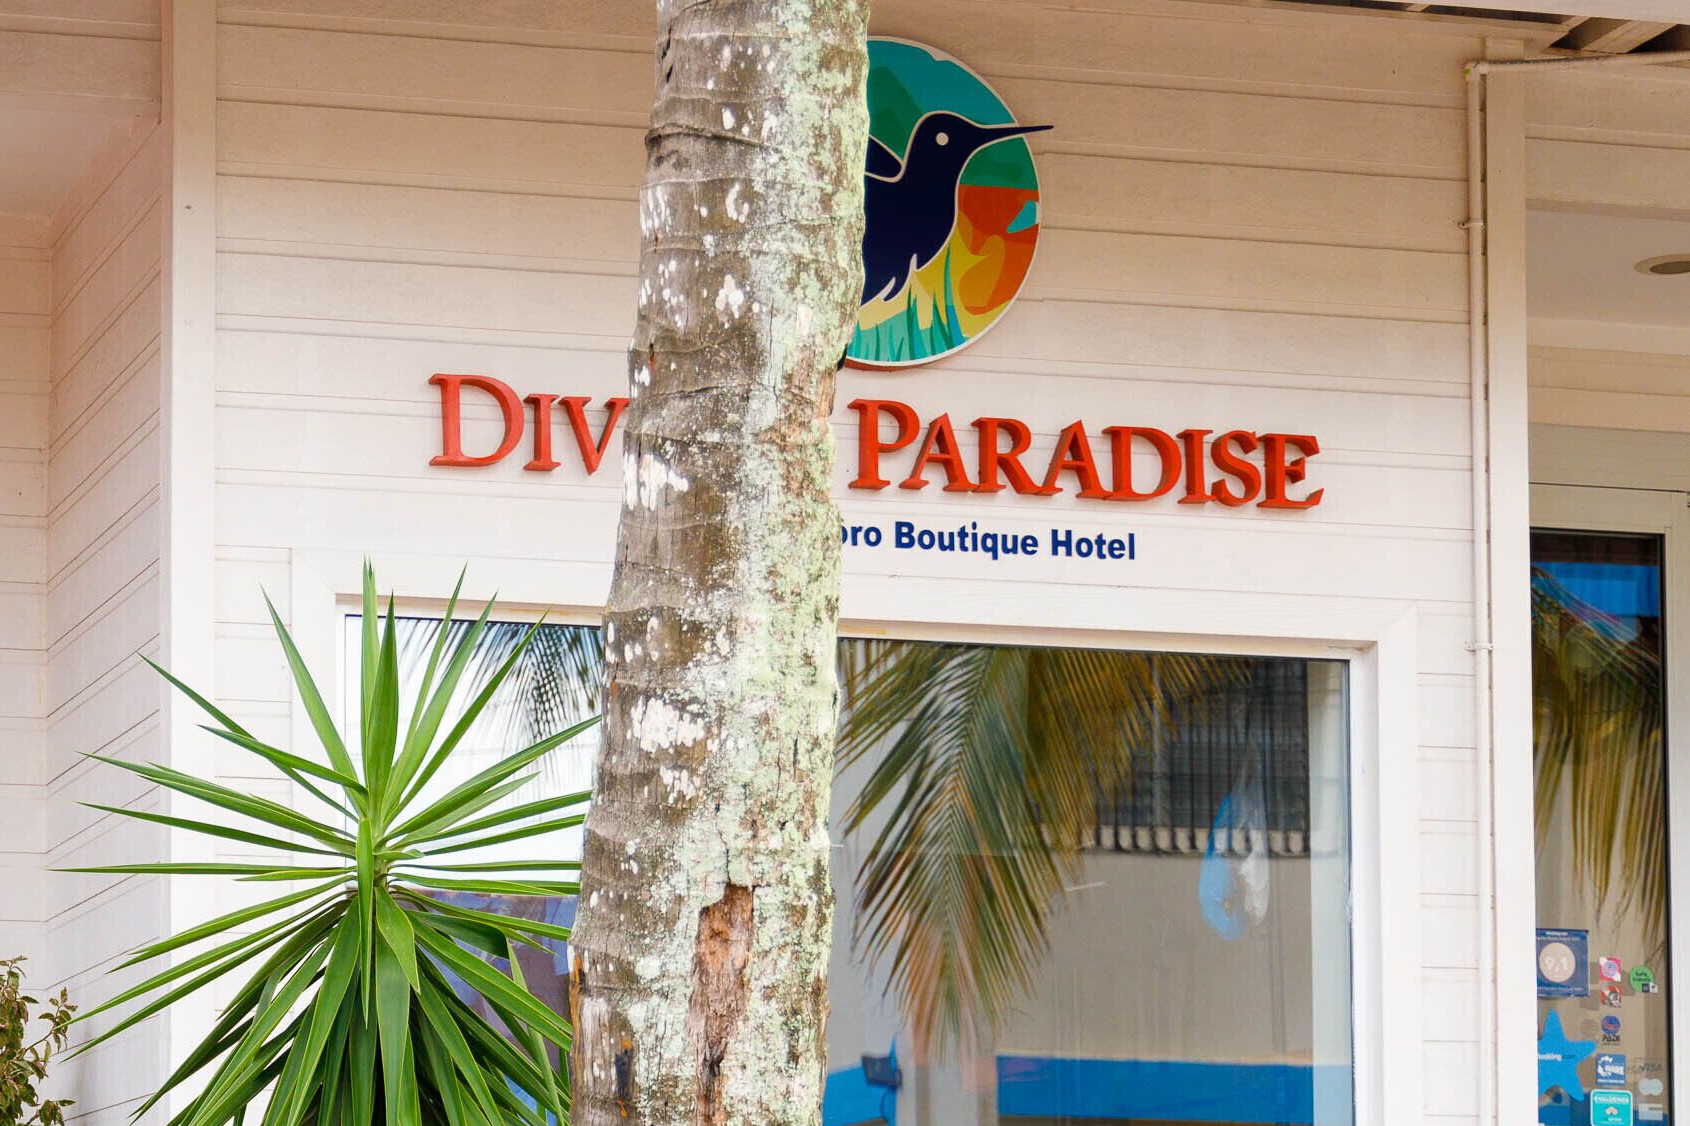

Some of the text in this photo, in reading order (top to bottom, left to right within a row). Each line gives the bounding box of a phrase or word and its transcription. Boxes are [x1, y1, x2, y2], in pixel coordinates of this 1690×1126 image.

[428, 373, 1324, 509] DIV PARADISE
[840, 521, 1136, 560] ro Boutique Hotel
